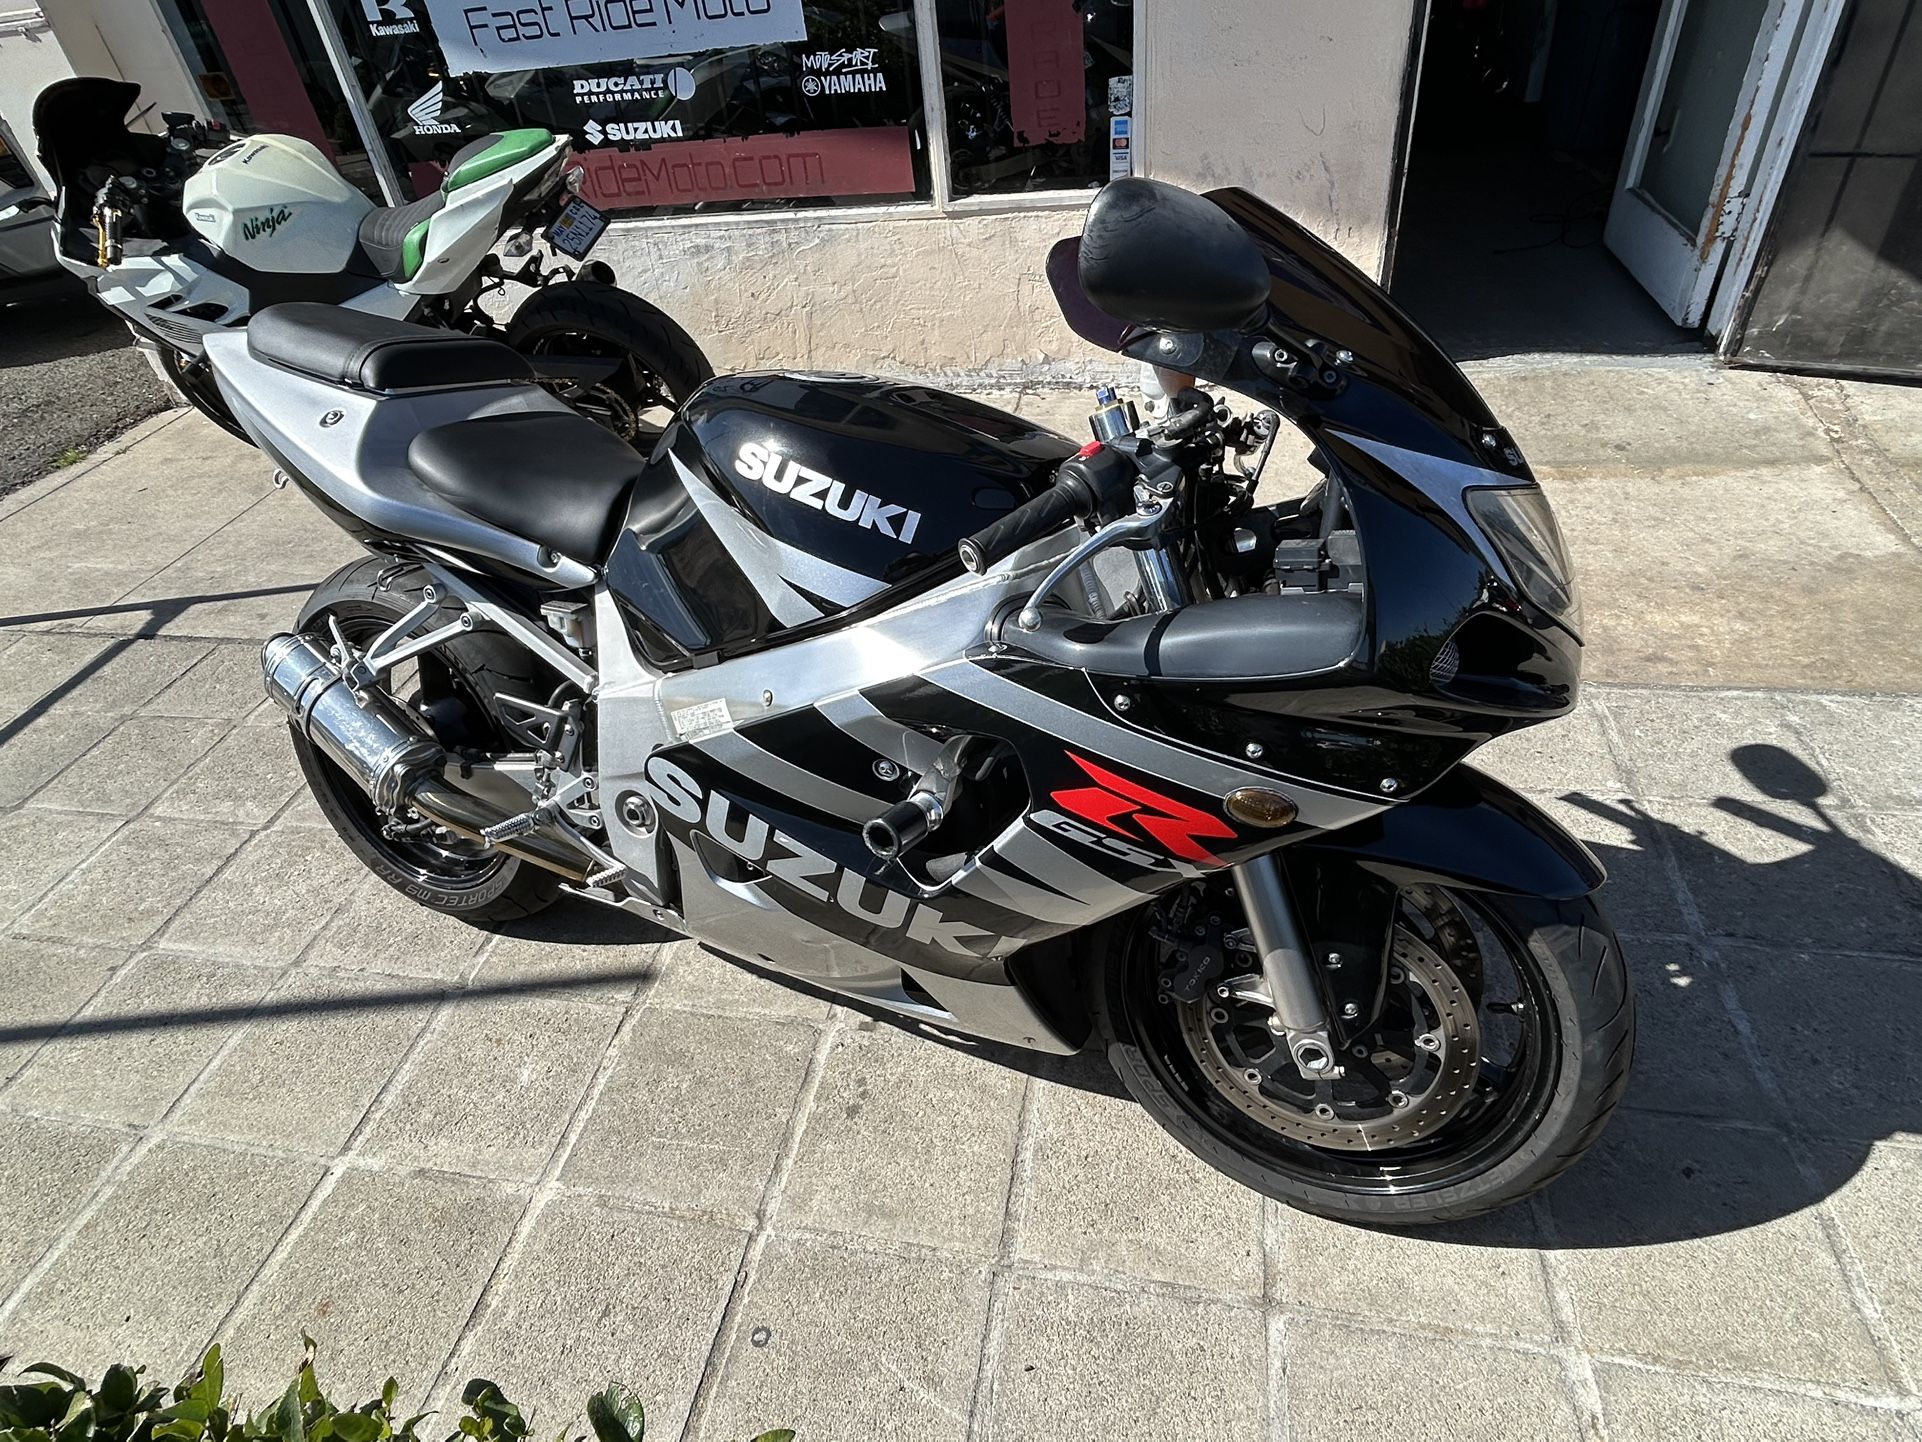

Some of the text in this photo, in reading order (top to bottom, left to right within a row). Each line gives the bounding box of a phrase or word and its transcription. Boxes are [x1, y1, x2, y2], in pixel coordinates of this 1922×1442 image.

[369, 20, 420, 37] Kawasaki
[463, 0, 561, 47] Fast
[573, 73, 664, 94] DUCATI
[821, 72, 887, 94] YAMAHA
[575, 89, 665, 104] PERFORMANCE
[413, 123, 461, 135] HONDA
[605, 120, 684, 141] SUZUKI
[242, 204, 293, 241] Ninja
[734, 443, 921, 544] SUZUKI
[434, 874, 510, 907] SPORTEC
